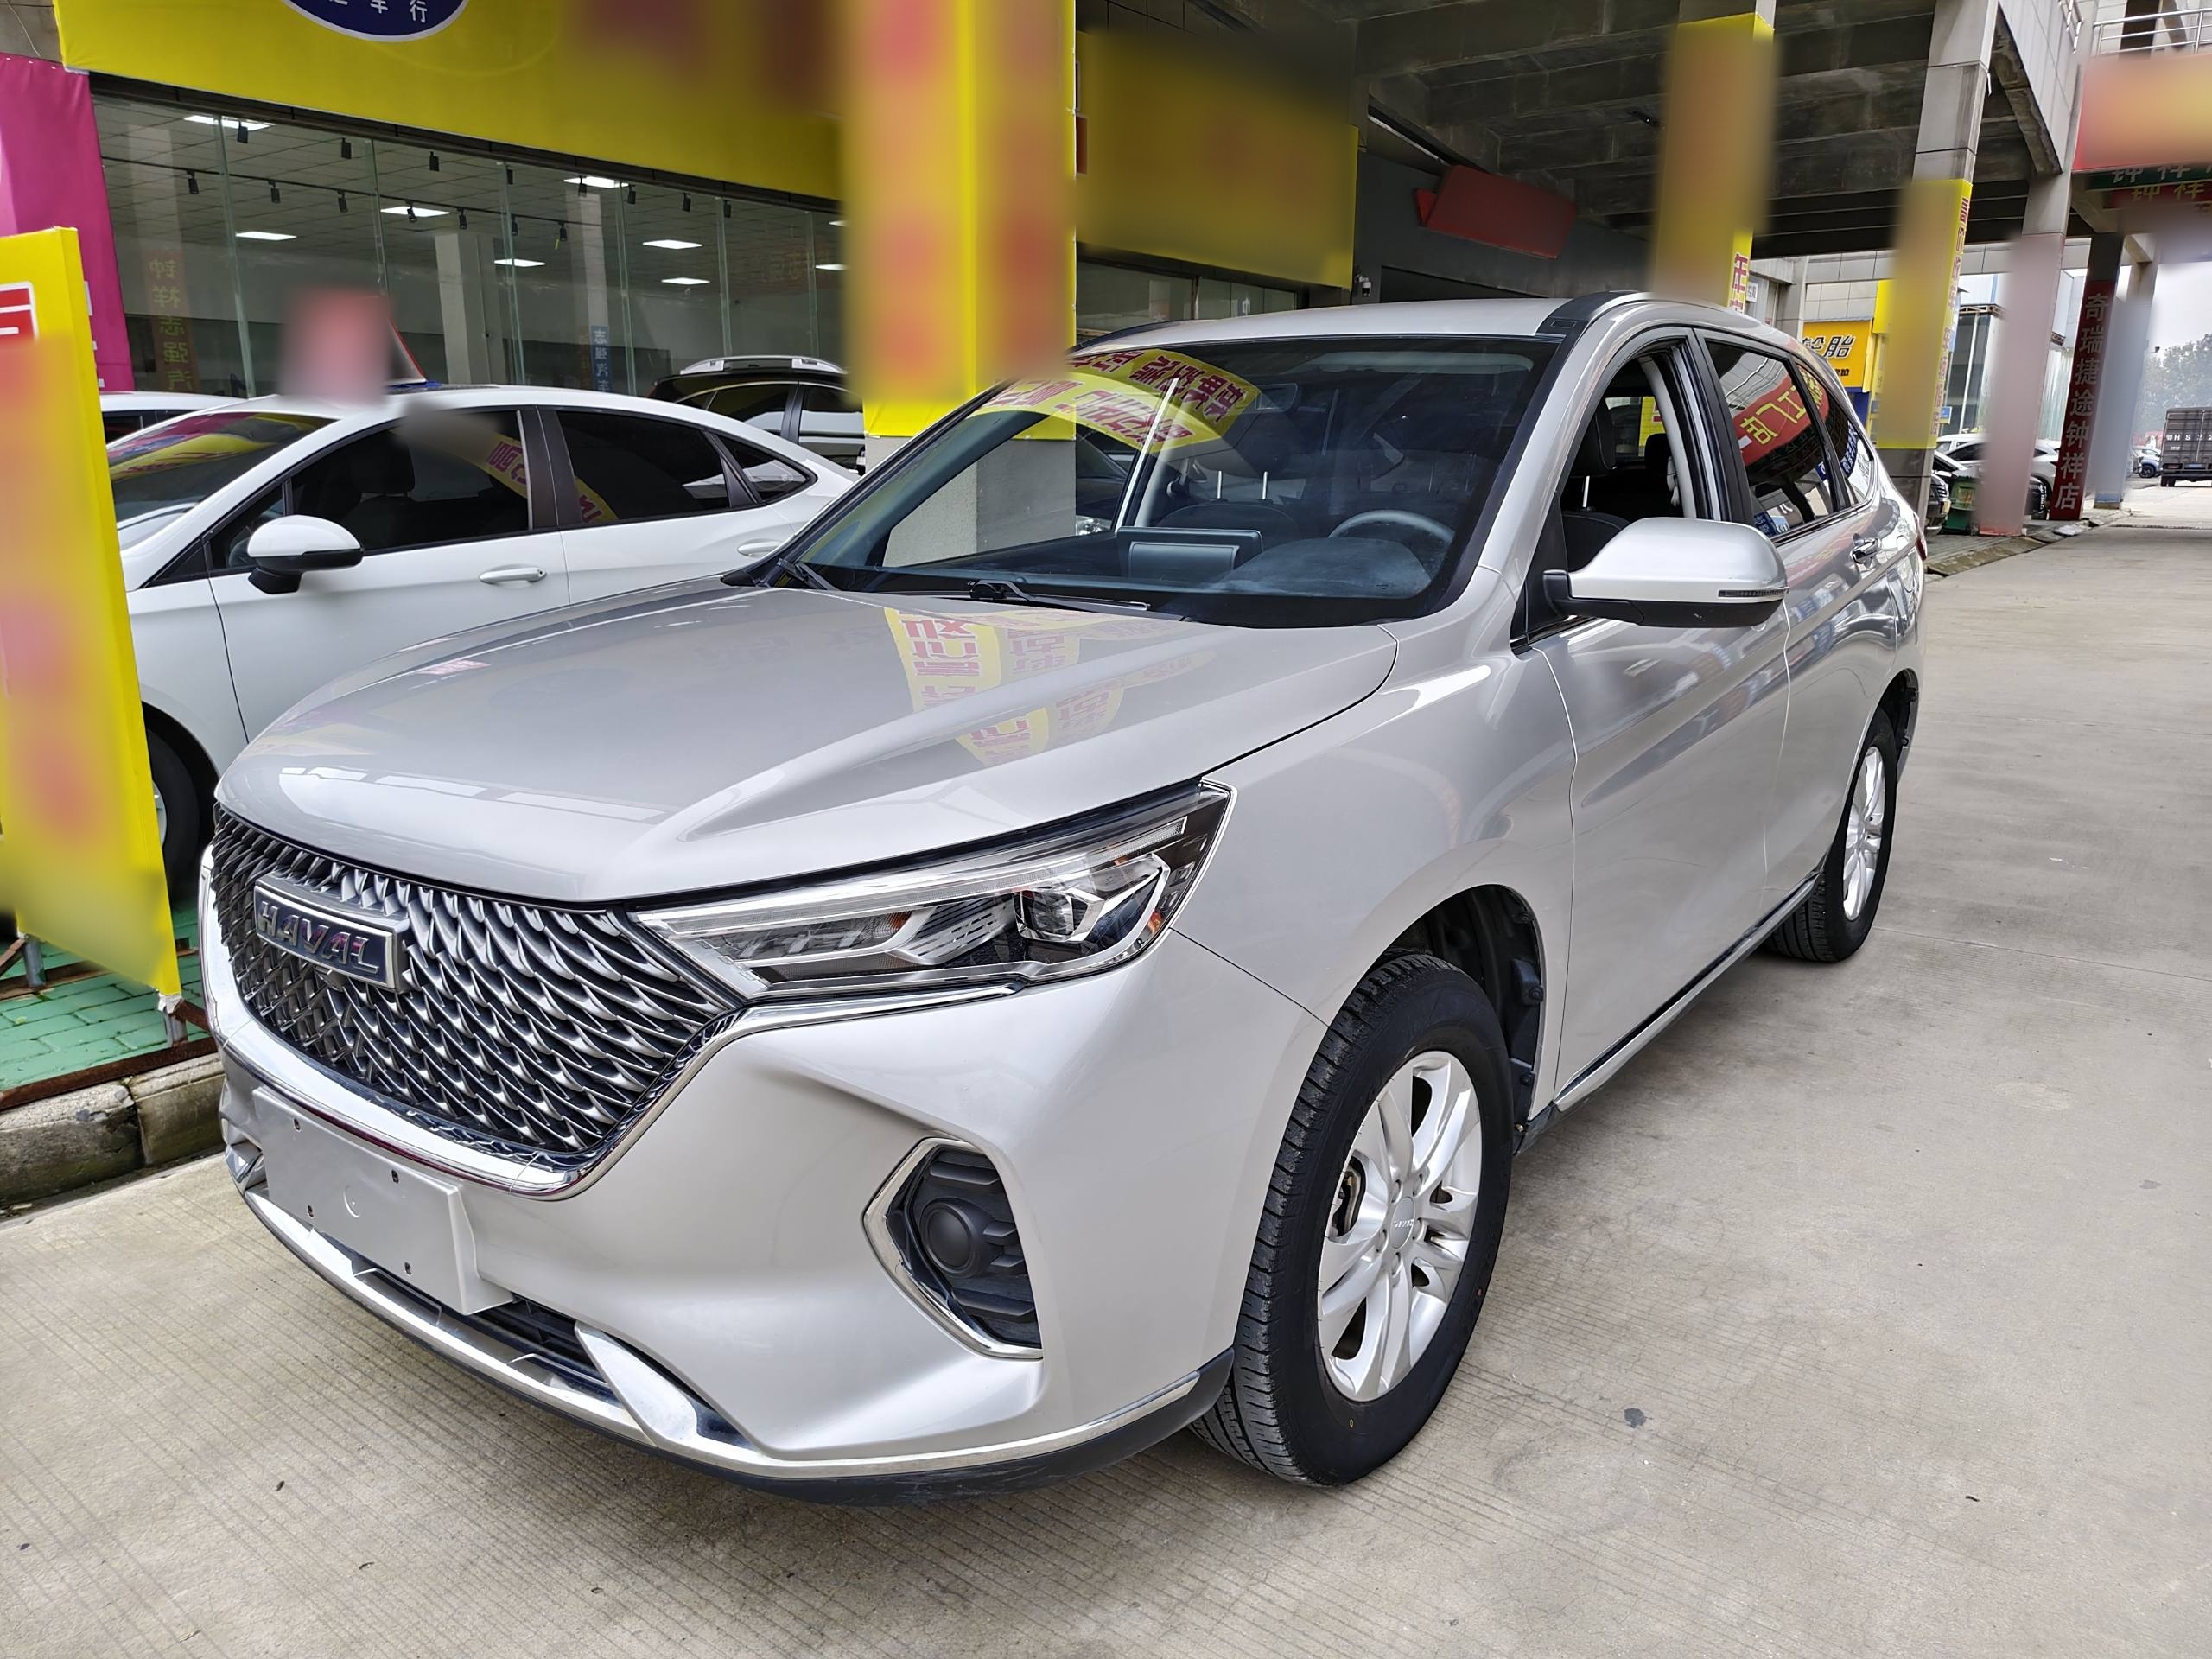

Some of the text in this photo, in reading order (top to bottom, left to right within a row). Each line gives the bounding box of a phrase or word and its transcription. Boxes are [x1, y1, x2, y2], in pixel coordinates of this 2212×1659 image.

[2055, 293, 2108, 510] 奇瑞捷途钟祥店
[258, 901, 379, 975] HAVAL
